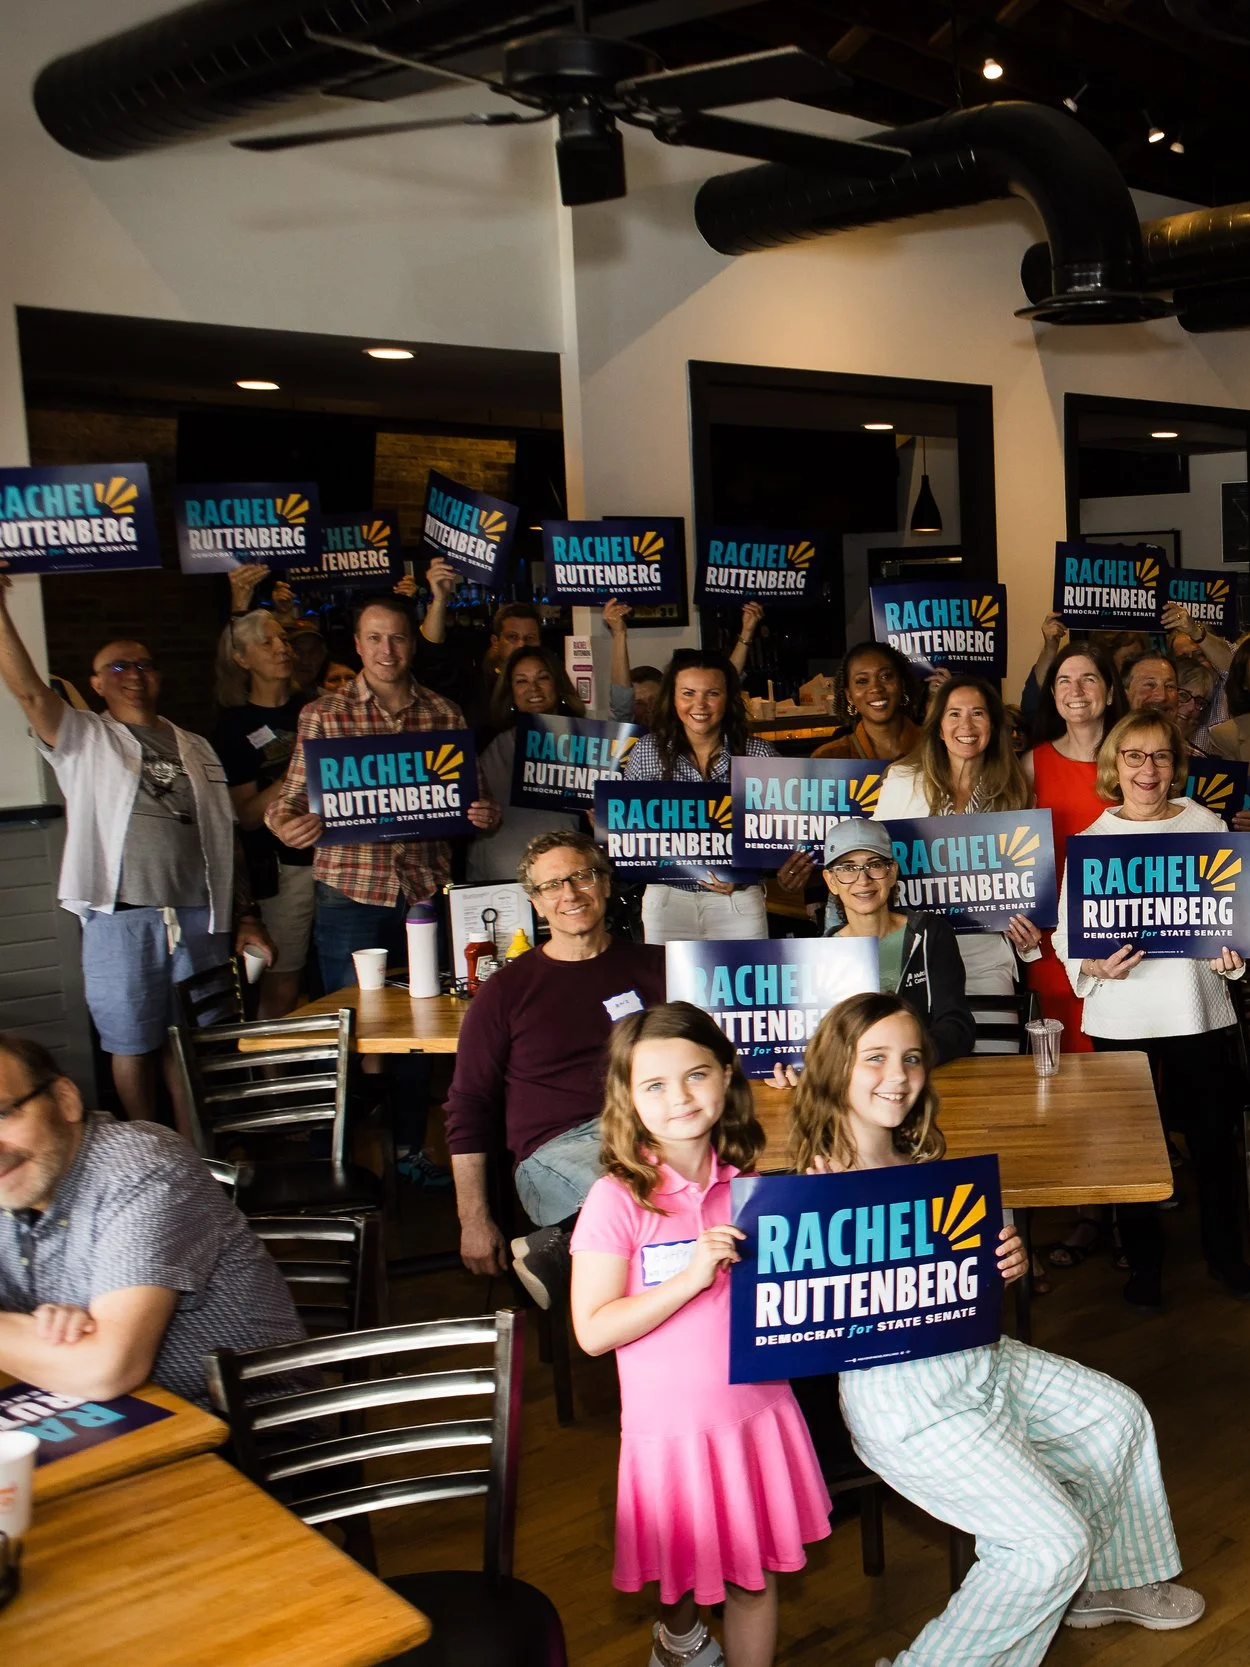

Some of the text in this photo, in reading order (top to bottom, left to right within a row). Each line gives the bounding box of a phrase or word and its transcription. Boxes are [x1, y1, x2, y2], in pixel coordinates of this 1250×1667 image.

[185, 498, 279, 527] RACHEL
[428, 486, 481, 534] RACHEL
[0, 517, 137, 551] UTTENBERG
[188, 525, 306, 552] RUTTENBERG
[424, 514, 497, 565] RUTTENBERG
[552, 536, 636, 562] RACHEL
[709, 540, 787, 568] RACHEL
[555, 563, 661, 586] RUTTENBERG
[706, 566, 806, 589] RUTTENBERG
[1065, 557, 1137, 587] RACHEL
[705, 587, 743, 596] DEMOCRAT
[1063, 585, 1156, 610] RUTTENBERG
[1169, 579, 1206, 601] CHEL
[884, 599, 973, 631] RACHEL
[526, 730, 612, 766] RACHEL
[320, 751, 429, 790] RACHEL
[323, 783, 461, 818] RUTTENBERG
[523, 786, 562, 796] DEMOCRAT
[745, 778, 850, 811] RACHEL
[326, 811, 462, 828] DEMOCRAT for STATE SENATE
[608, 799, 710, 830] RACHEL
[745, 842, 794, 850] DEMOCRAT
[892, 835, 1001, 876] RACHEL
[659, 860, 674, 868] for
[1083, 856, 1200, 895] RACHEL
[949, 902, 1036, 915] for STATE SENATE
[1083, 897, 1233, 928] RUTTENBERG
[1084, 931, 1139, 939] DEMOCRAT
[1141, 930, 1158, 939] for
[693, 963, 818, 1007] RACHEL
[752, 1047, 771, 1057] for
[757, 1199, 934, 1275] RACHEL
[755, 1256, 978, 1328] RUTTENBERG
[755, 1306, 976, 1347] DEMOCRAT for STATE SENATE
